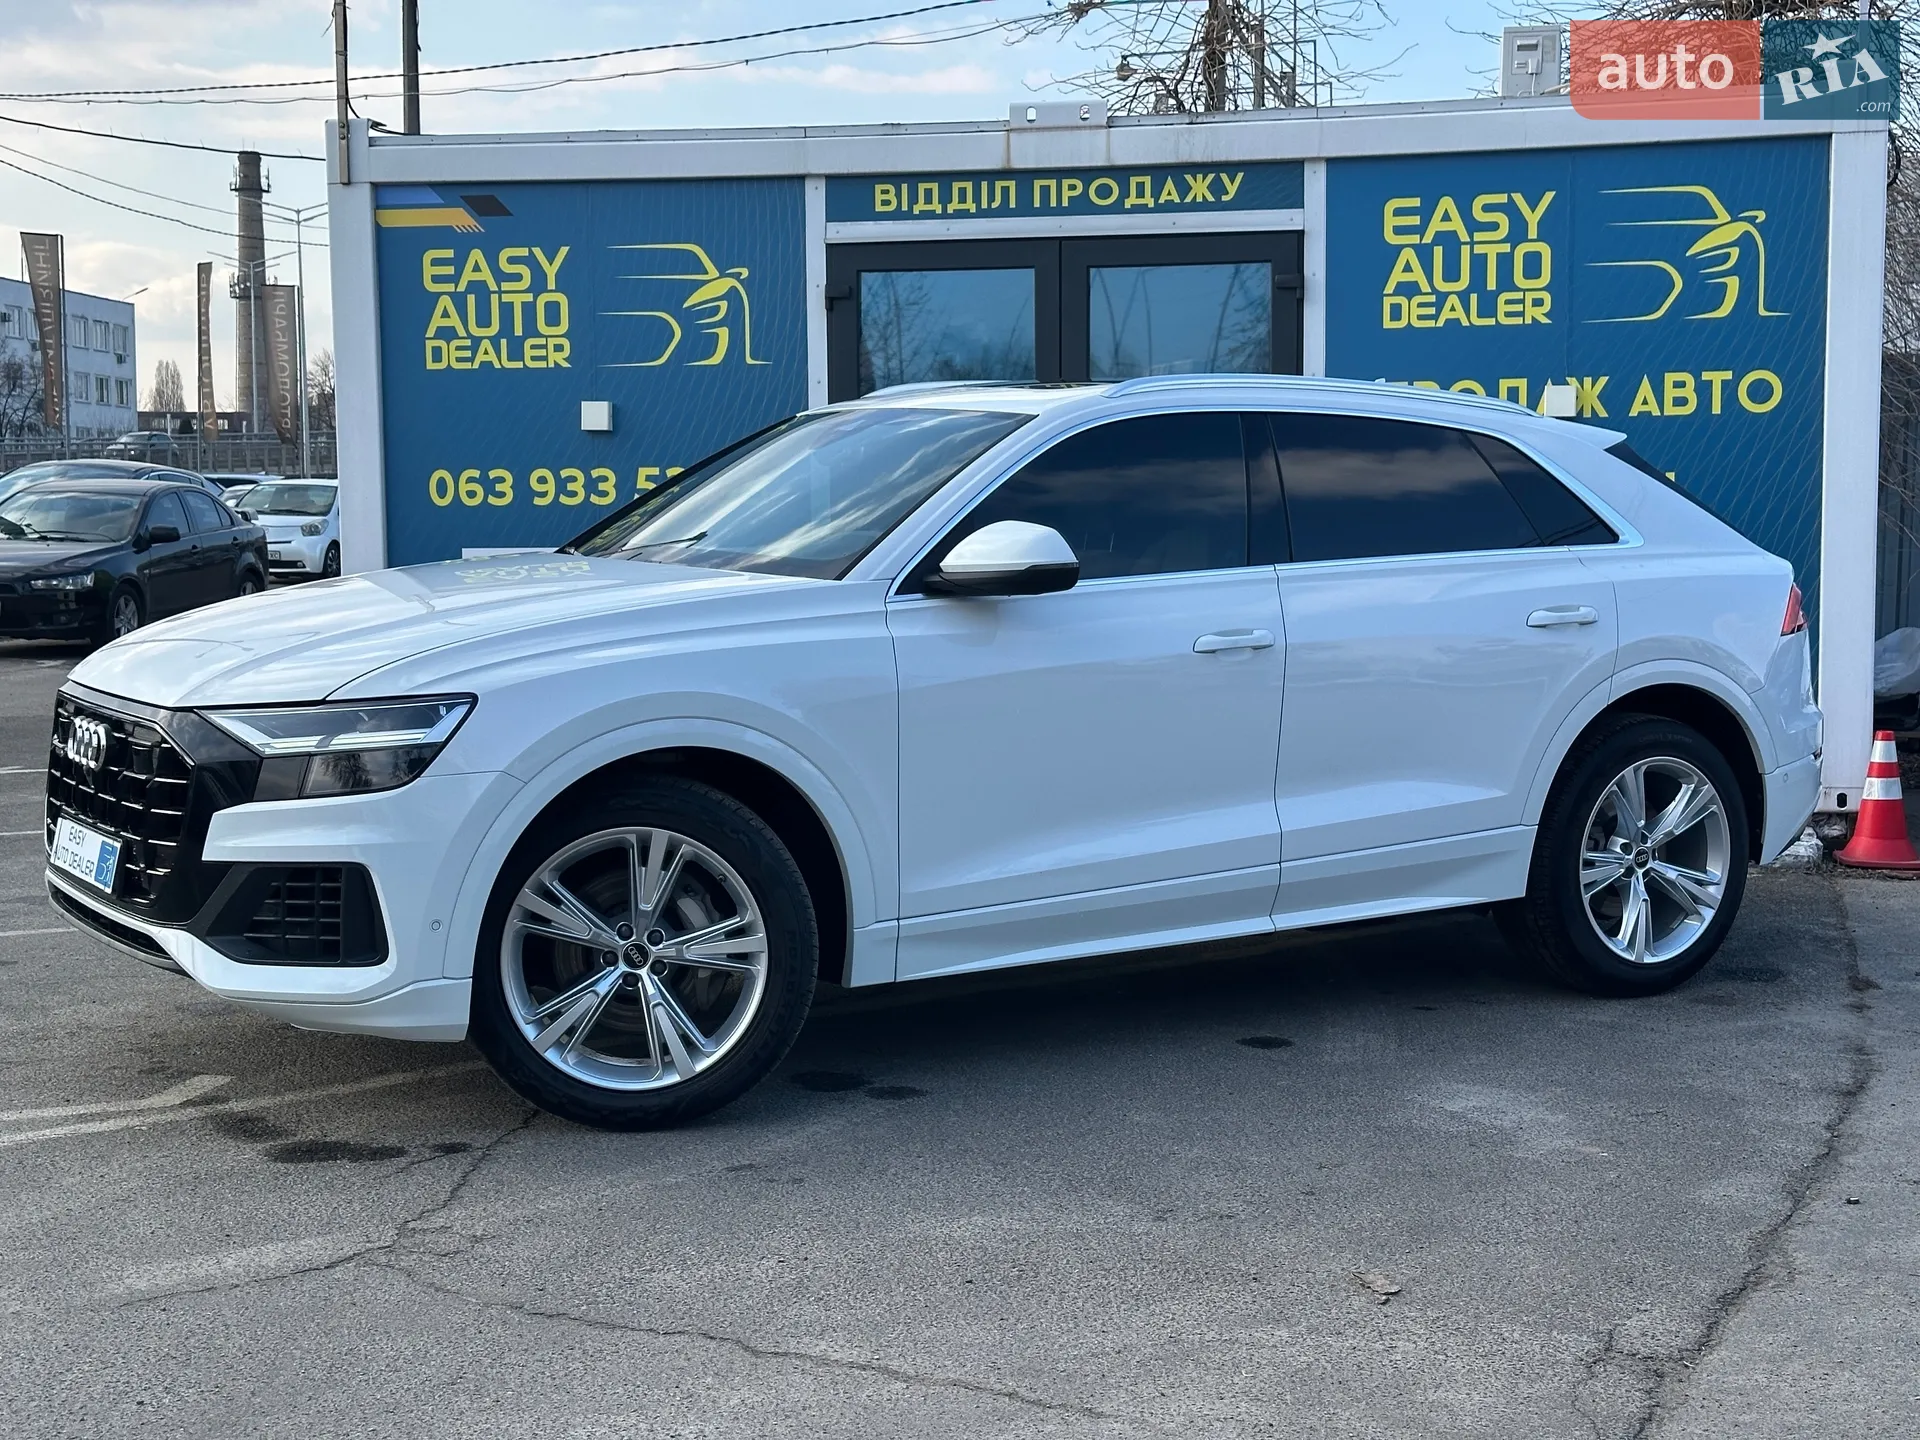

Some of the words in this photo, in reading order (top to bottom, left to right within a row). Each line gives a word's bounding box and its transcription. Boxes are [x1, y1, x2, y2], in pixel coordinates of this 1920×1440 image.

[875, 180, 1016, 214] ВІДДІЛ
[1033, 172, 1244, 208] ПРОДАЖУ
[1383, 191, 1556, 245] EASY
[422, 246, 570, 292] EASY
[1383, 241, 1552, 294] AUTO
[425, 292, 569, 337] AUTO
[1382, 291, 1552, 329] DEALER
[425, 337, 572, 370] DEALER
[1628, 369, 1783, 417] АВТО
[428, 468, 514, 507] 063
[529, 467, 617, 506] 933
[69, 826, 87, 847] EASY
[69, 850, 95, 878] DEALER
